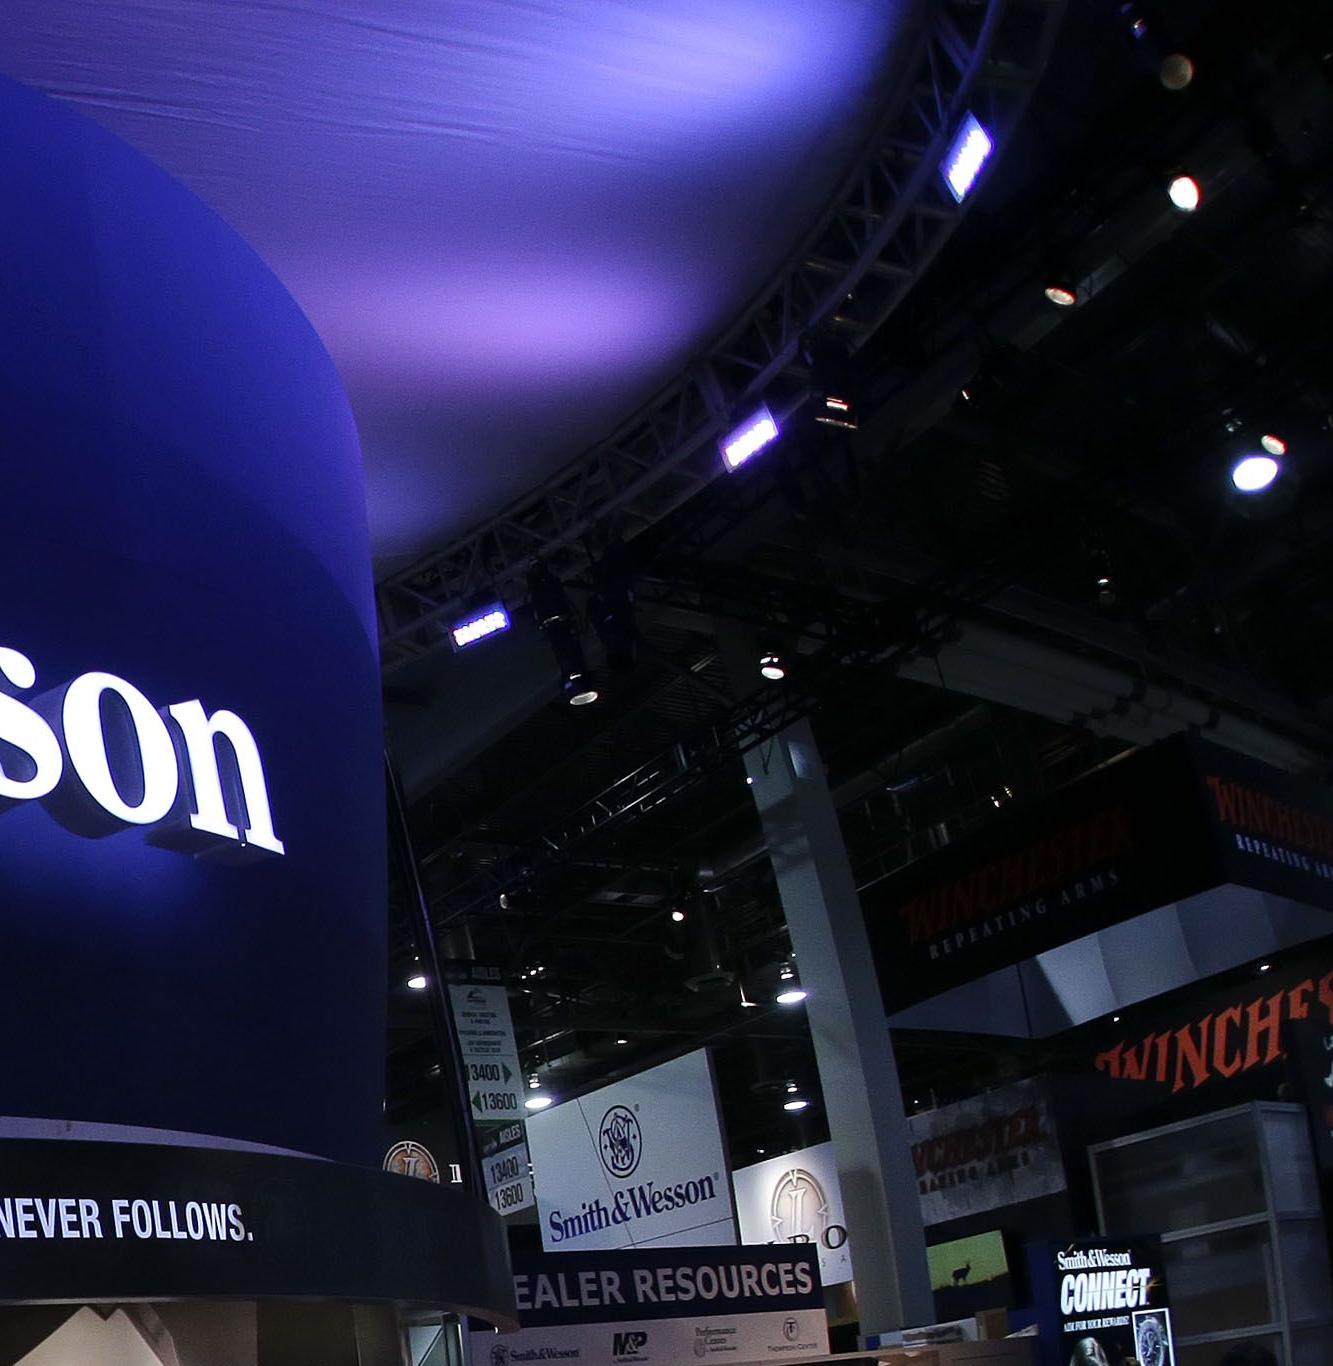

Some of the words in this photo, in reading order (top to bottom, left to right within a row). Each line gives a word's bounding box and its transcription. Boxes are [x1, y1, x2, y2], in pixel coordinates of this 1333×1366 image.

[1061, 867, 1120, 906] ARMS
[482, 1091, 518, 1112] 13600
[111, 1198, 254, 1243] FOLLOWS.
[514, 1269, 626, 1311] EALER
[634, 1260, 814, 1304] RESOURCES
[1060, 1267, 1150, 1316] CONNECT
